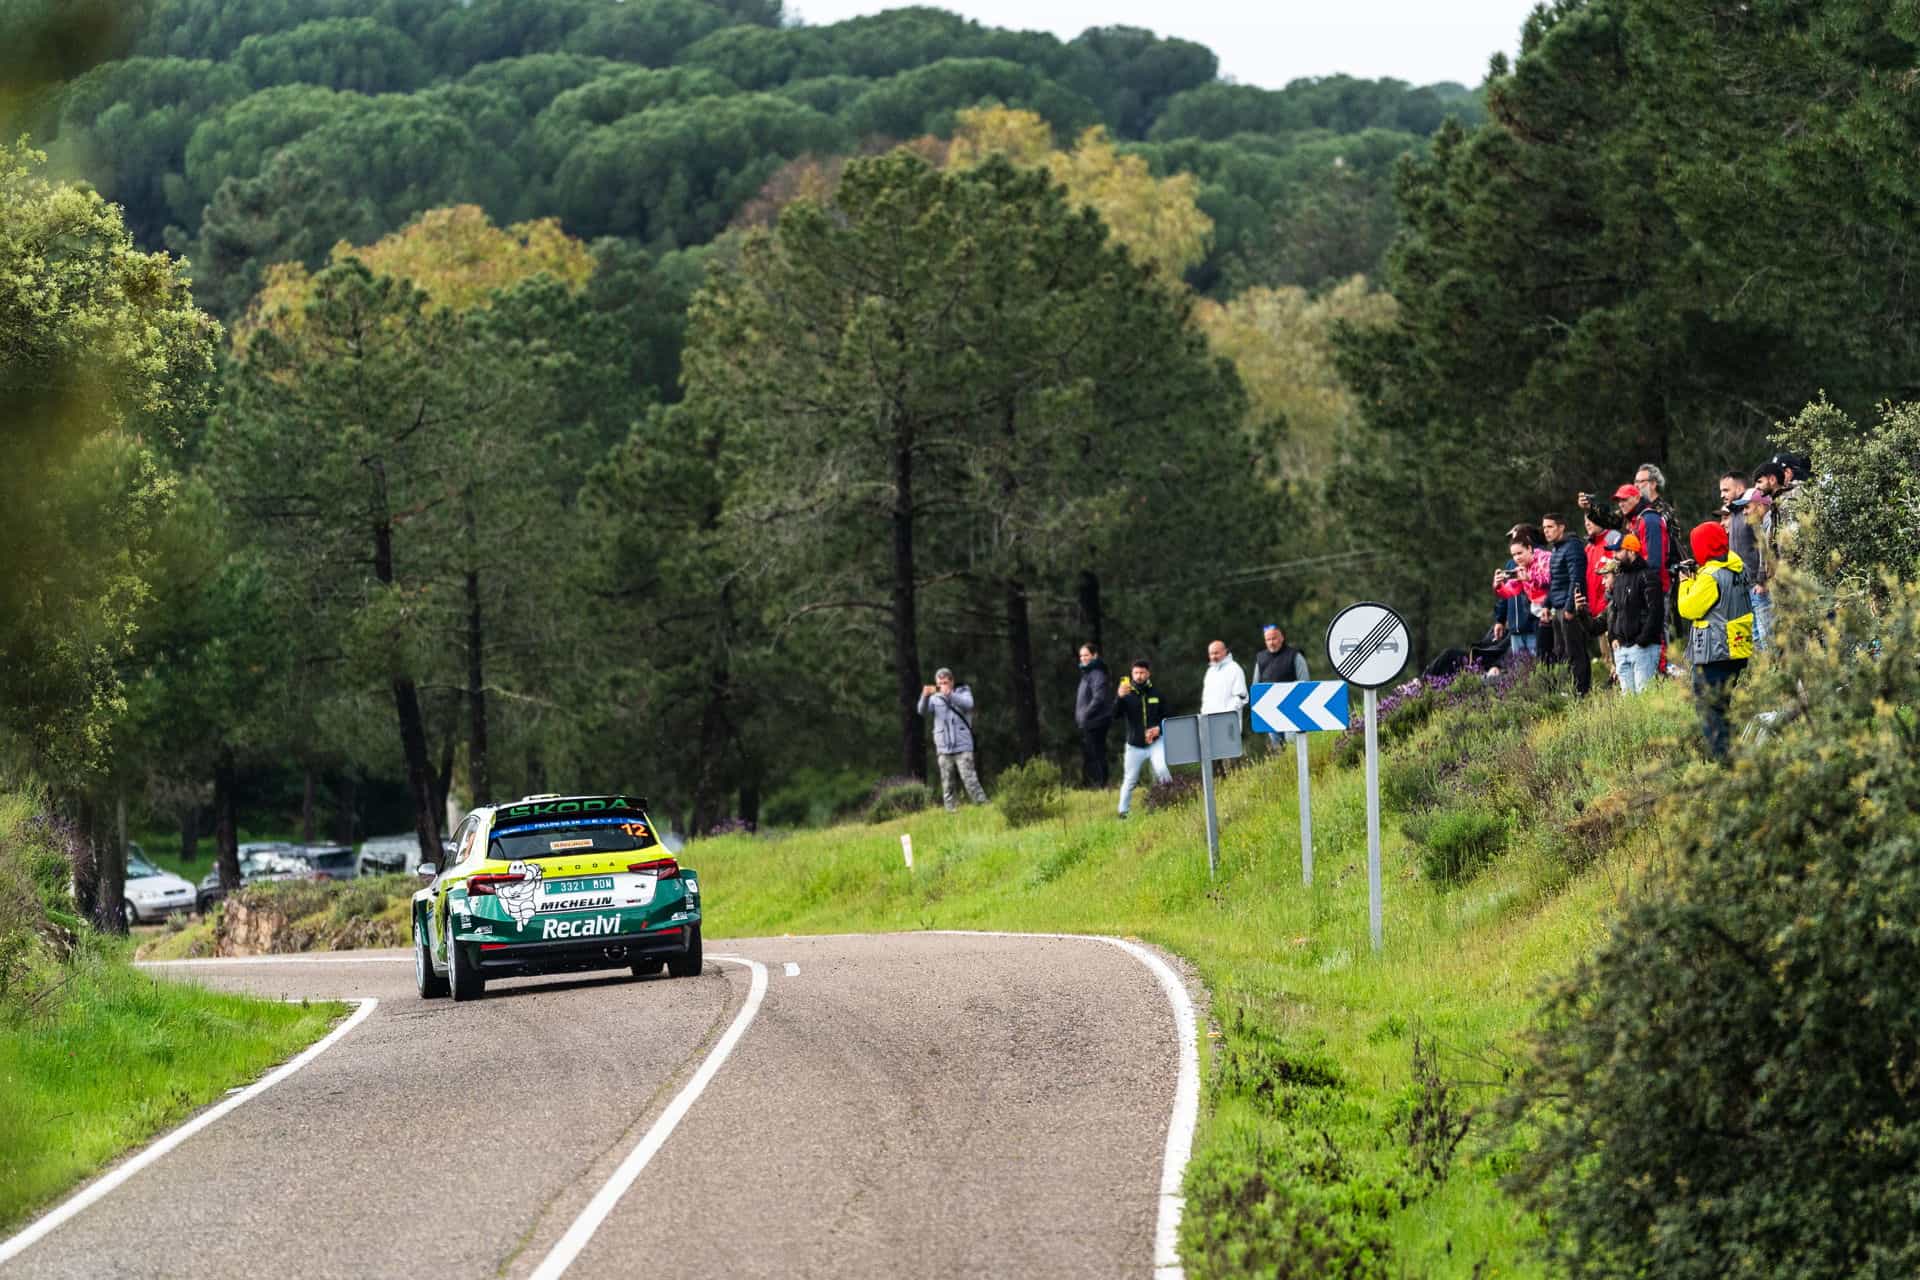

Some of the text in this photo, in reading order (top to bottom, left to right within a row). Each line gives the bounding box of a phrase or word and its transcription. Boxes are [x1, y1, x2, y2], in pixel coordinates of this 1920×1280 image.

[621, 823, 649, 837] 12
[545, 883, 552, 894] P
[560, 880, 585, 892] 3321
[541, 897, 612, 910] MICHELIN
[542, 913, 621, 939] Recalvi
